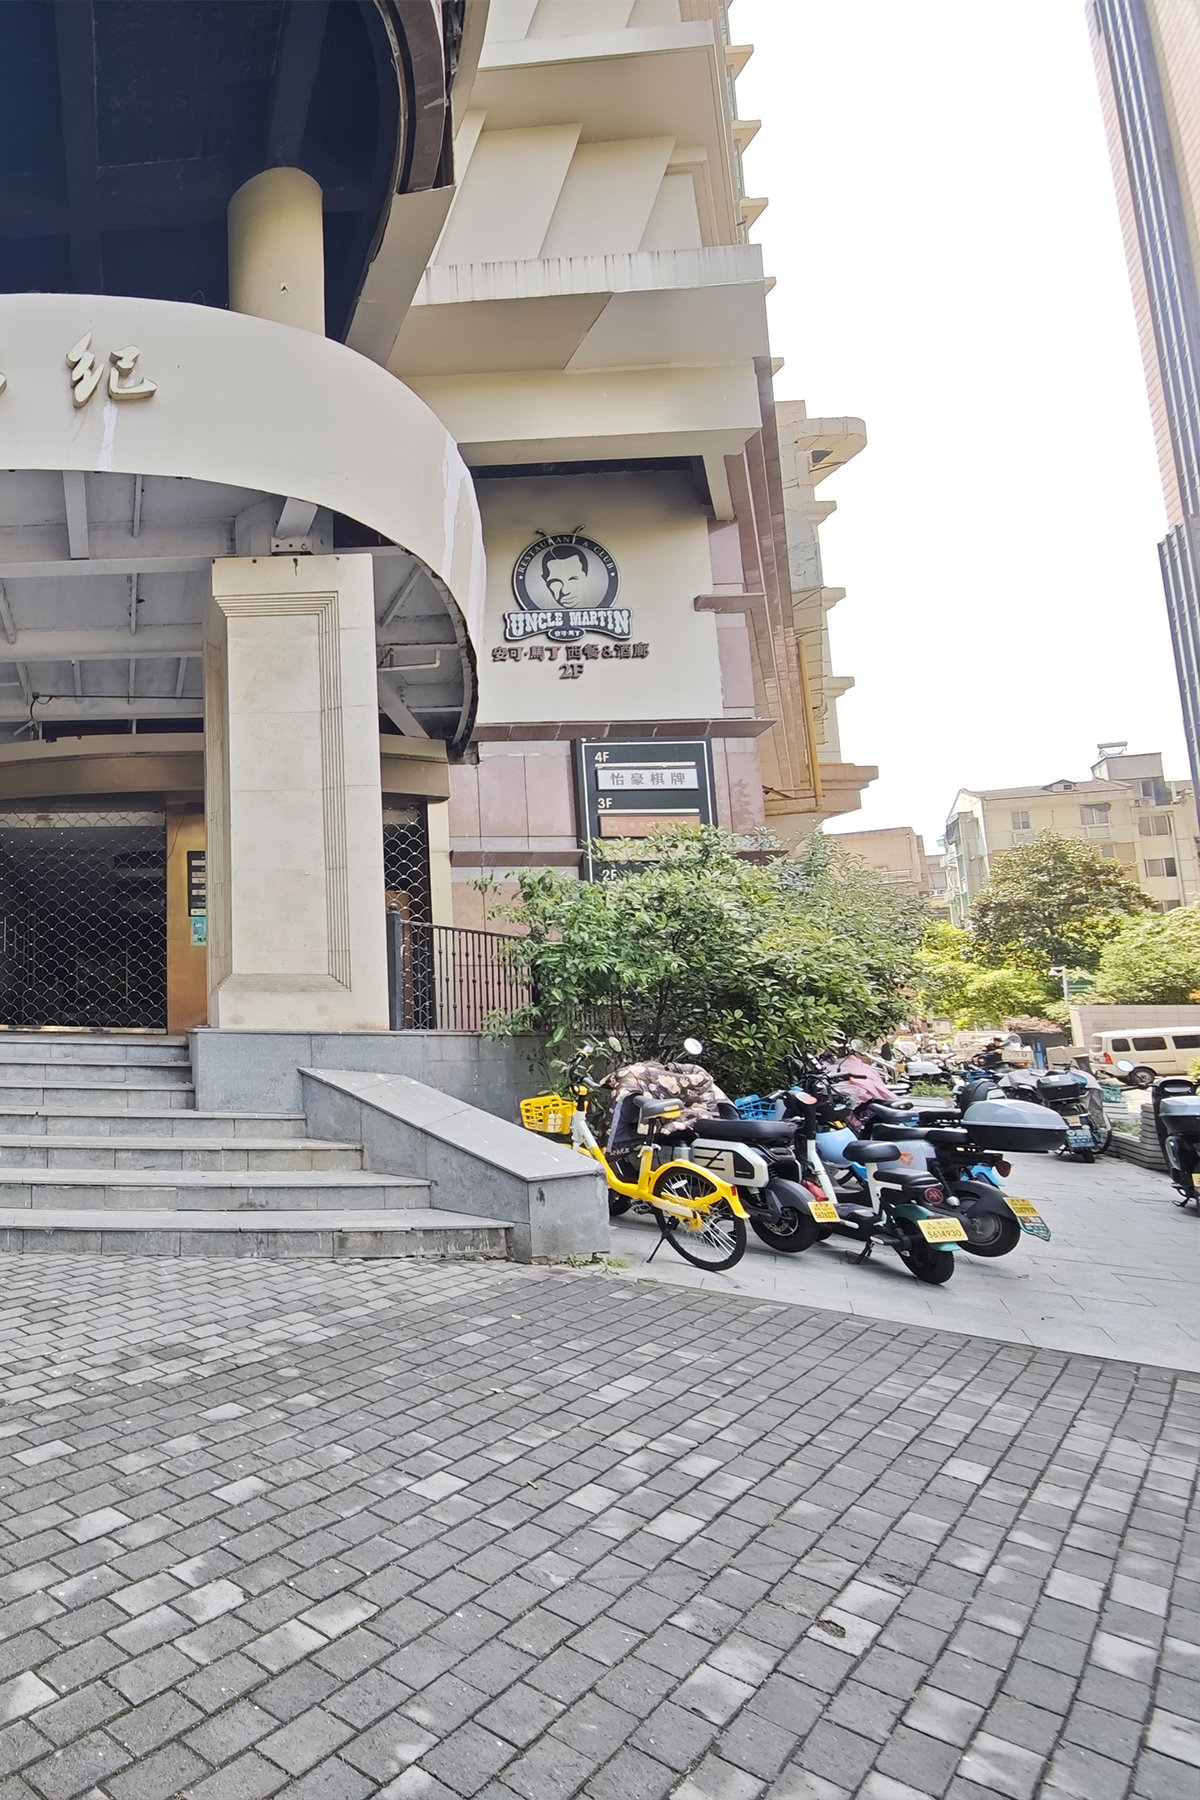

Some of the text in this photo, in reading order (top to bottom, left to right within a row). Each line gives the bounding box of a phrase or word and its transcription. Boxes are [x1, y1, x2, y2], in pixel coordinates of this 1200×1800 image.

[593, 546, 615, 569] CLUB
[510, 610, 629, 637] UNCLE MARTIN
[559, 663, 584, 679] 2F
[594, 751, 610, 762] 4F
[610, 772, 686, 786] 怡豪棋牌
[597, 797, 613, 809] 3F
[602, 869, 617, 880] 2F
[927, 1230, 962, 1239] 5614930
